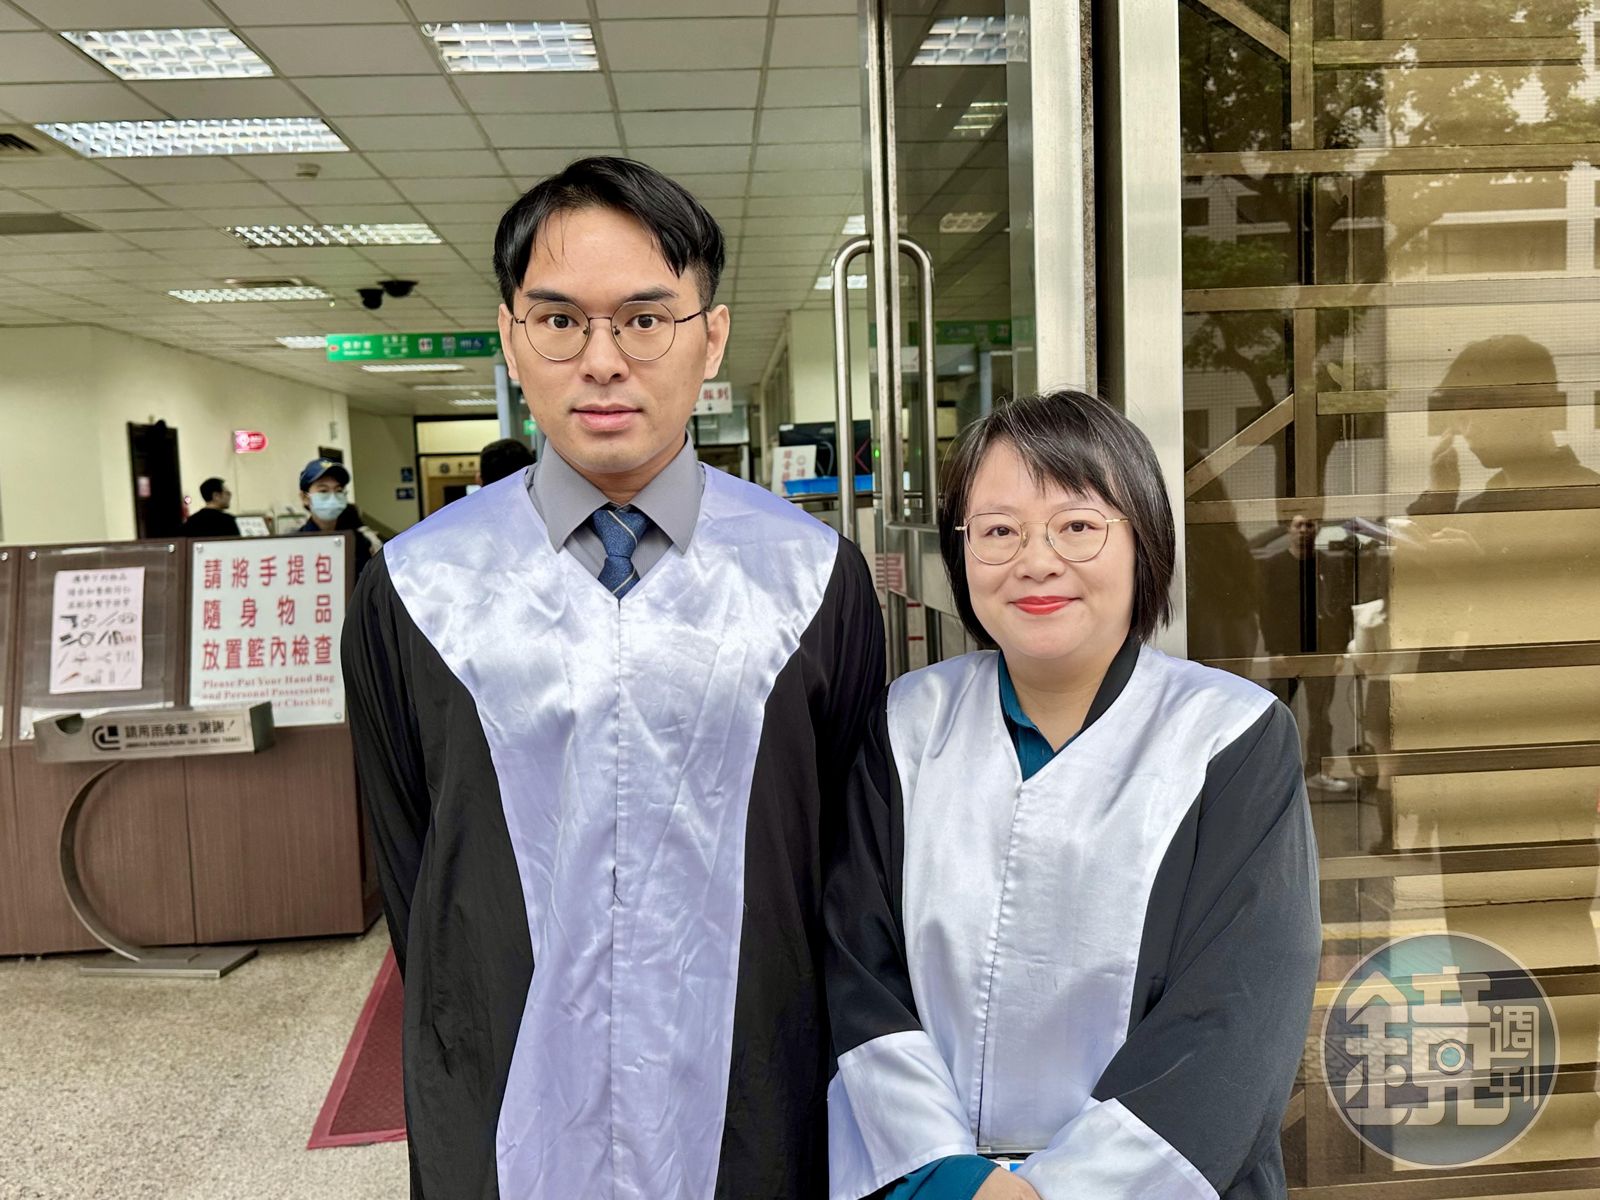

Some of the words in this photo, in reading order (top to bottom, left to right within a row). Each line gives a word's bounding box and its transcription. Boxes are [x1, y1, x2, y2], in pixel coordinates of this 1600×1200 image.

[204, 553, 333, 589] 請將手提包
[203, 594, 332, 630] 隨身物品
[202, 634, 332, 671] 放置籃內檢查
[203, 680, 235, 688] Please
[238, 679, 255, 687] Put
[258, 677, 281, 685] Your
[285, 675, 313, 684] Hand
[316, 674, 335, 684] Bag
[224, 688, 269, 699] Personal
[285, 698, 333, 707] Checking
